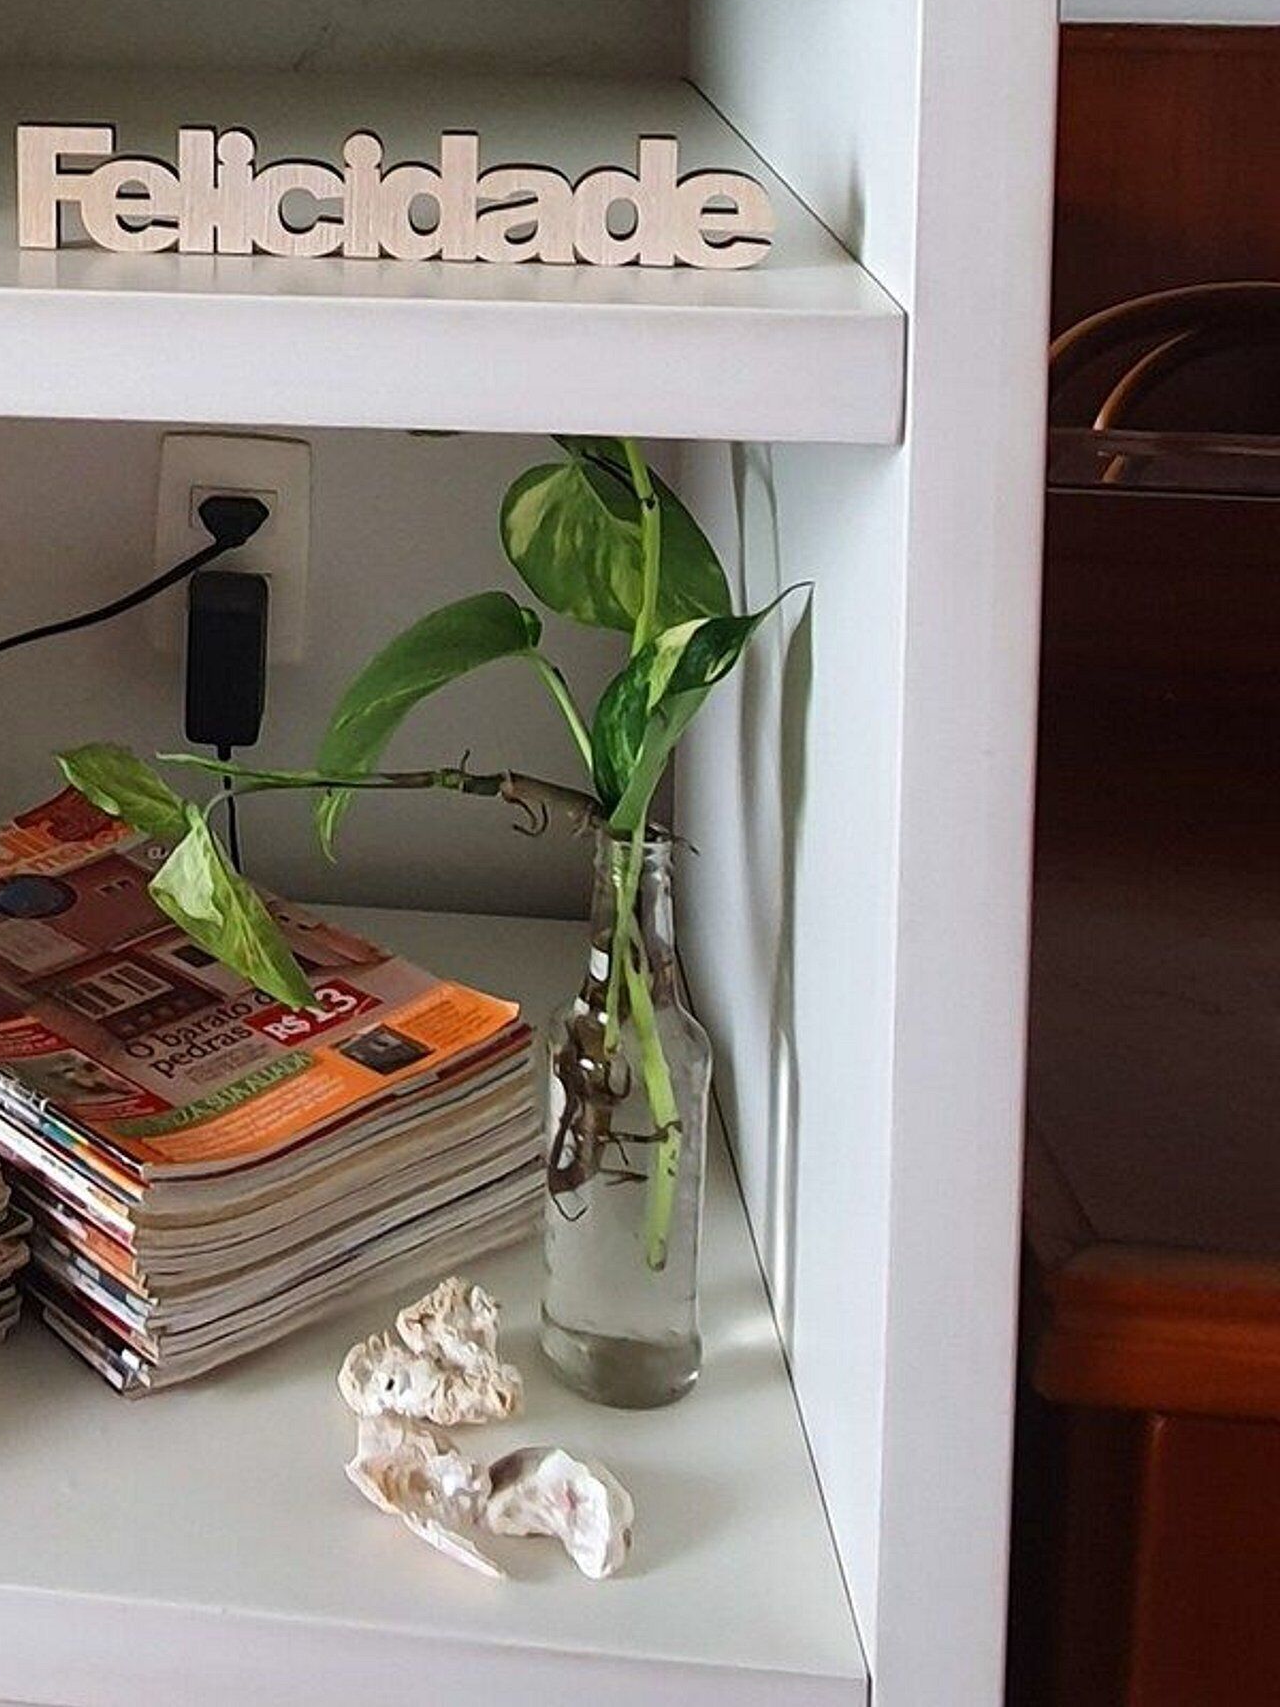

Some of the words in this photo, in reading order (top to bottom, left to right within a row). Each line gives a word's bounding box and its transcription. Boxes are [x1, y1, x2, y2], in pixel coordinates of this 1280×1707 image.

[16, 122, 776, 270] Felicidade
[146, 1001, 253, 1048] barato
[261, 1014, 312, 1041] R$
[149, 1024, 254, 1079] pedras
